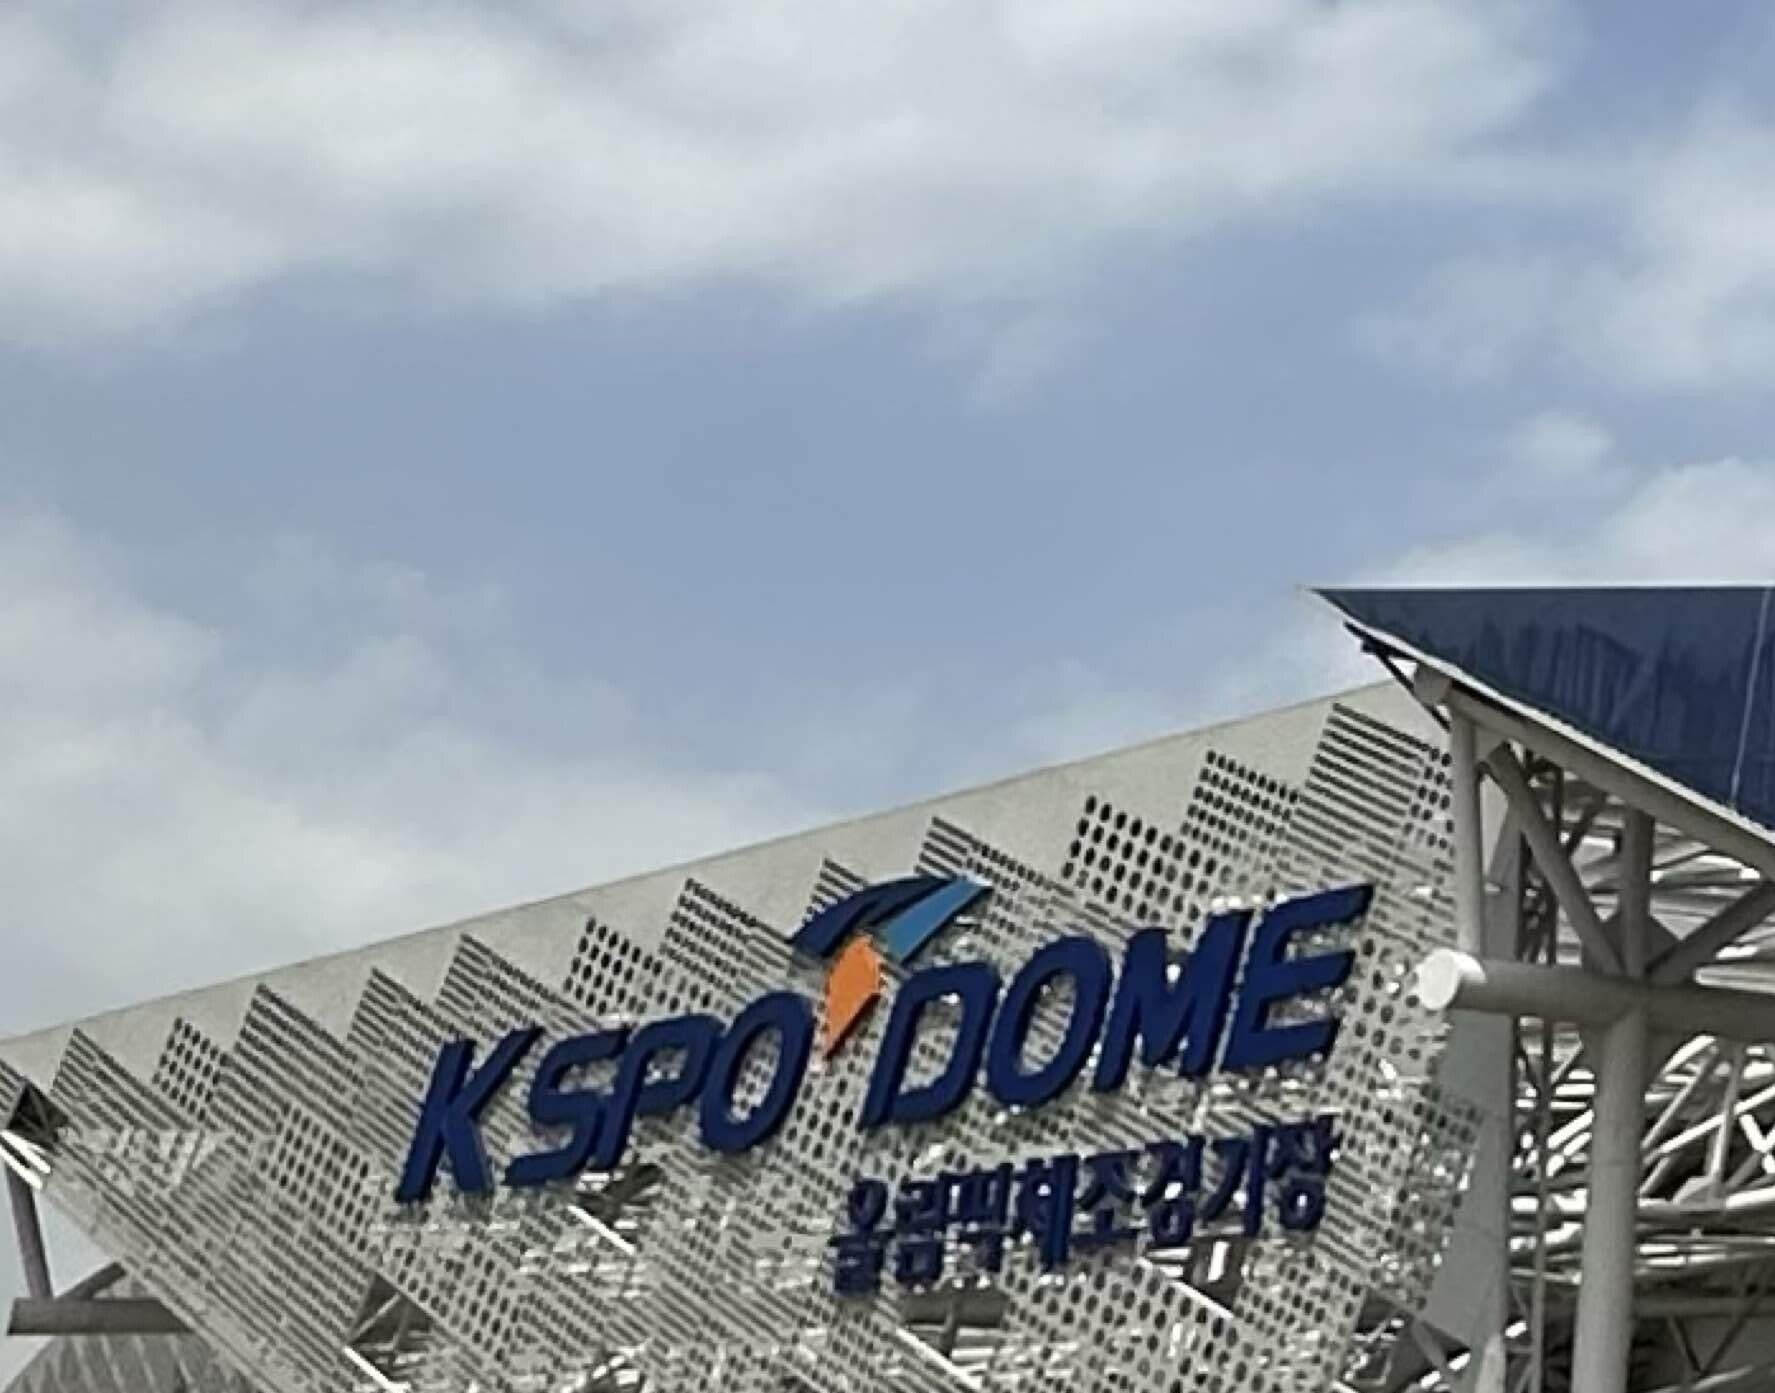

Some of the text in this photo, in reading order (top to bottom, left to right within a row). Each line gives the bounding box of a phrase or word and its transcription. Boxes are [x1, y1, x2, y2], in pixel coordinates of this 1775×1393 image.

[394, 882, 1376, 1203] KSPO DOME
[828, 1114, 1342, 1295] 올림픽체조경기장
